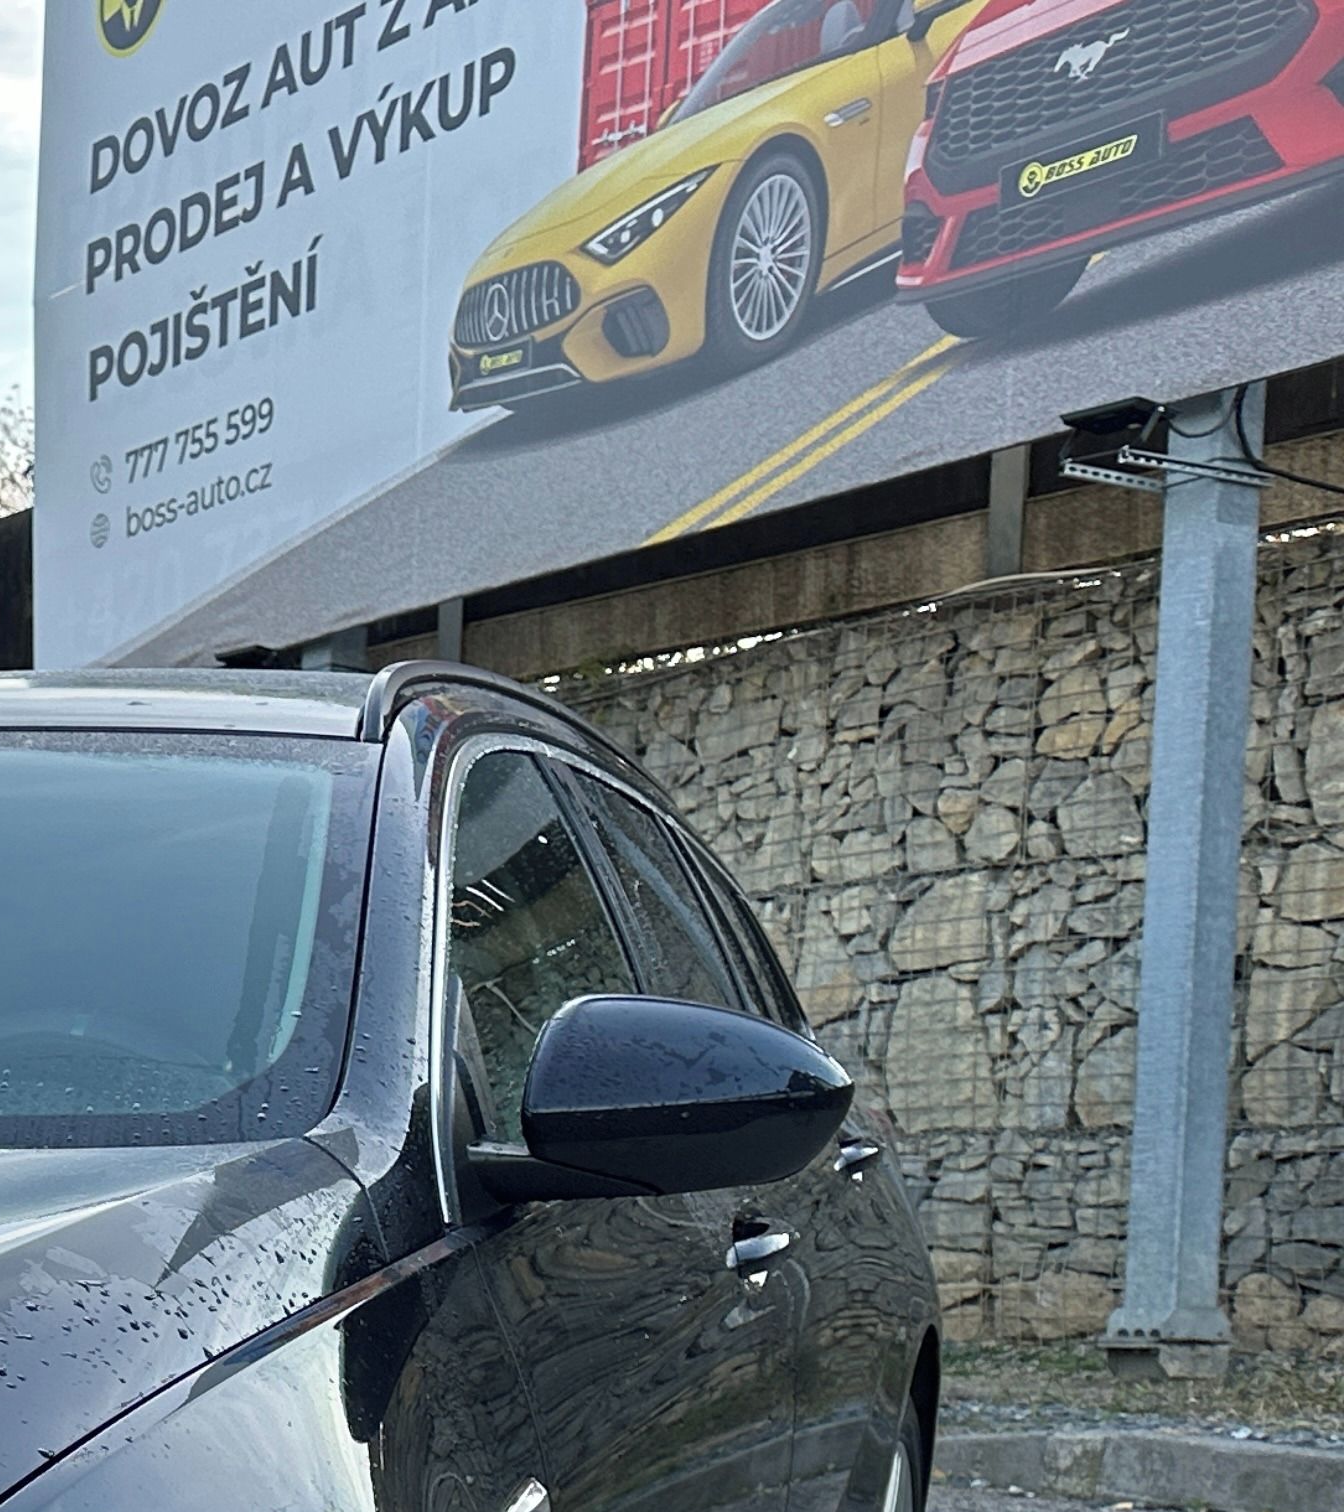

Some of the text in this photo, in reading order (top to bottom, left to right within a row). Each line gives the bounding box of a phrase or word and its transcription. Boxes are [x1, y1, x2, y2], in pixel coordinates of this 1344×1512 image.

[90, 62, 251, 194] DOVOZ
[261, 4, 366, 109] AUT
[1045, 138, 1133, 180] BOSS AUTO
[86, 47, 516, 295] PRODEJ A VÝKUP
[86, 234, 323, 402] POJIŠTĚNÍ
[125, 397, 274, 484] 777 755 599
[126, 462, 272, 538] boss-auto.cz
